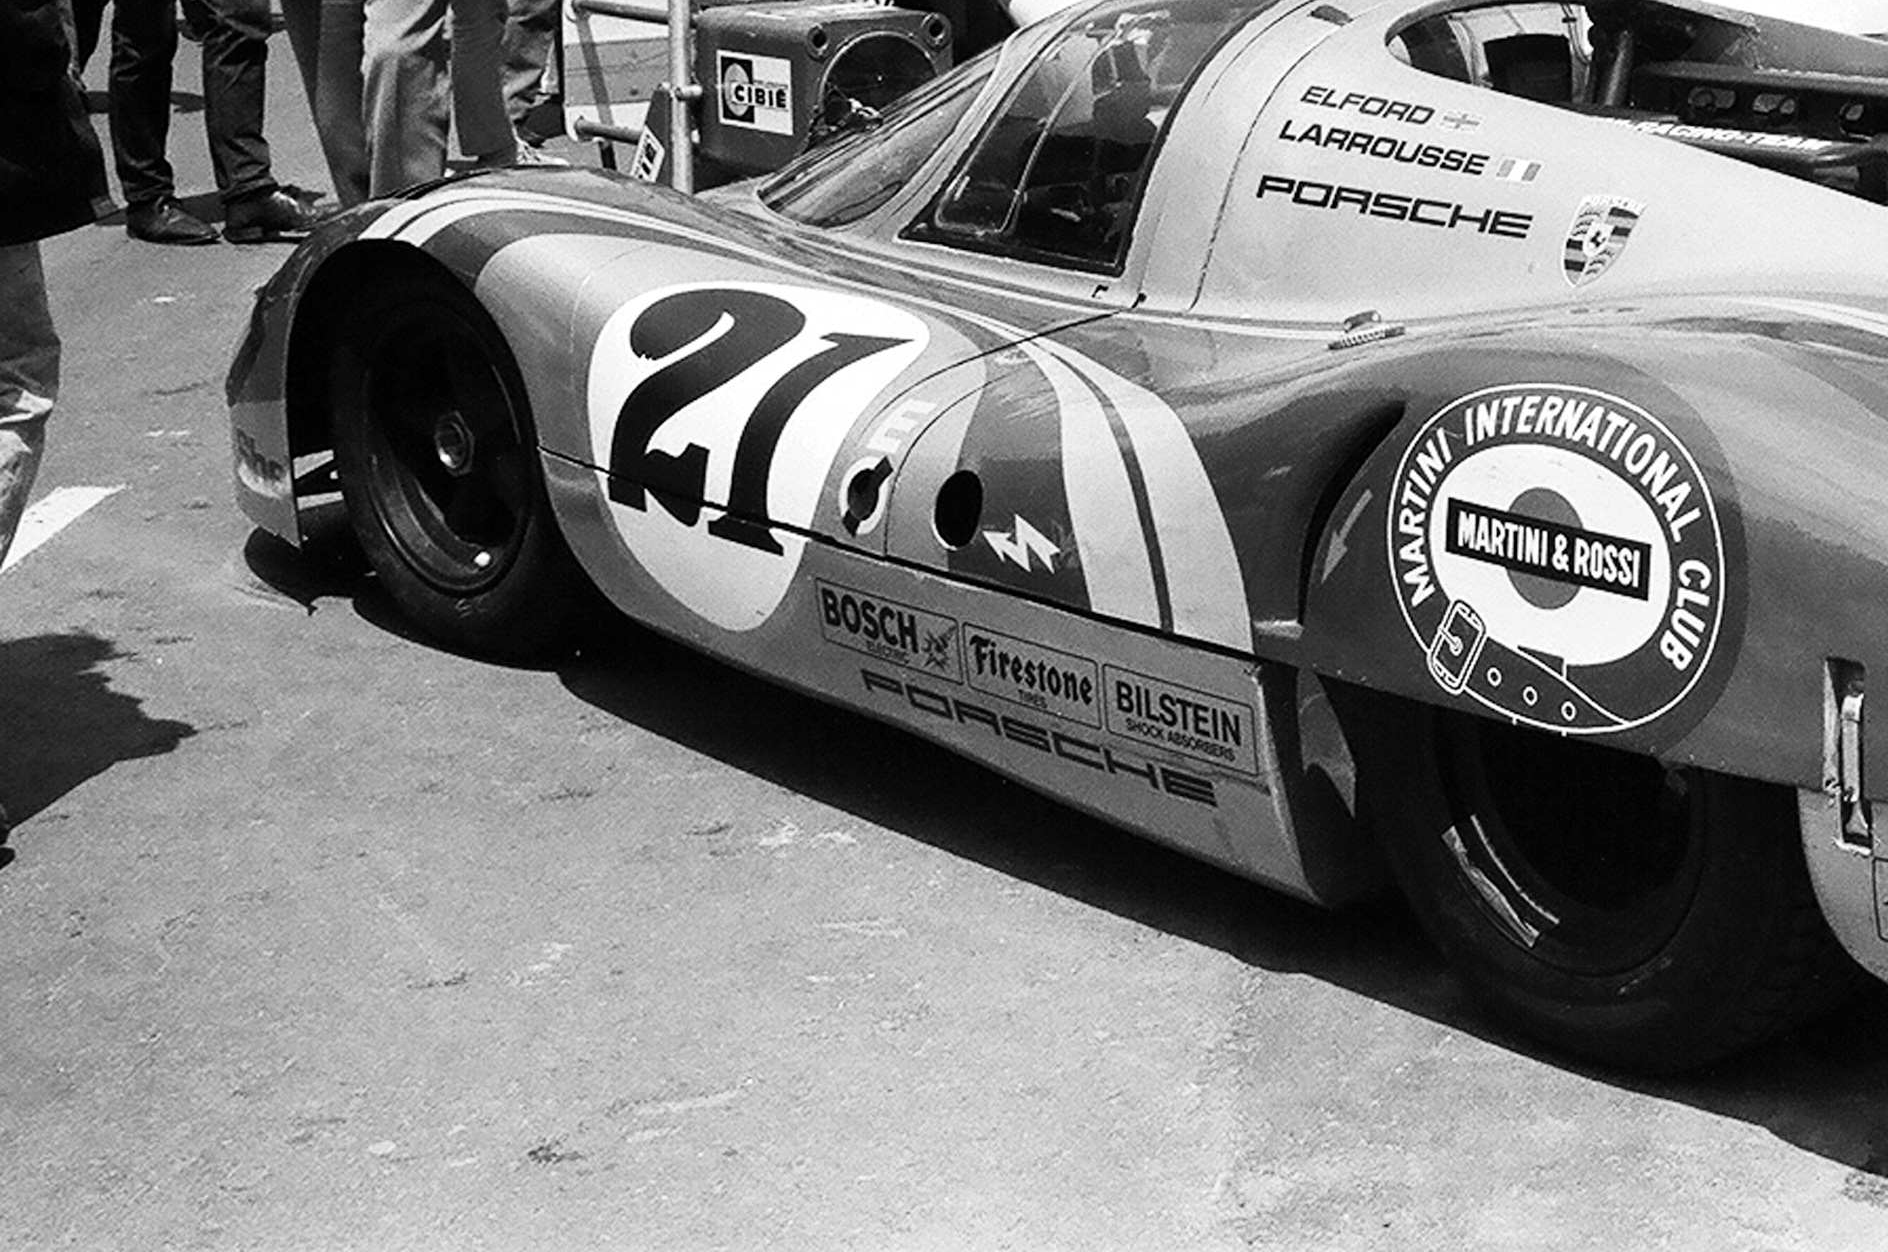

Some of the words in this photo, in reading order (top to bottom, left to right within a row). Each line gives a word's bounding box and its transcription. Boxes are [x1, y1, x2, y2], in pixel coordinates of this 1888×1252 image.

[1300, 85, 1436, 126] ELFORD
[1279, 119, 1491, 176] LARROUSSE
[1256, 174, 1534, 240] PORSCHE
[608, 288, 915, 557] 21
[1399, 427, 1453, 607] MARTINI
[1464, 395, 1701, 544] INTERNATIONAL
[1659, 559, 1712, 671] CLUB
[1457, 510, 1549, 567] MARTINI
[1551, 534, 1571, 571] &
[1573, 541, 1641, 588] ROSSI
[821, 588, 919, 654] BOSCH
[969, 634, 1094, 706] Firestone
[860, 667, 1220, 808] PORSCHE
[1115, 680, 1242, 747] BILSTEIN
[1125, 717, 1165, 741] SHOCK
[1167, 730, 1237, 763] ABSORBERS
